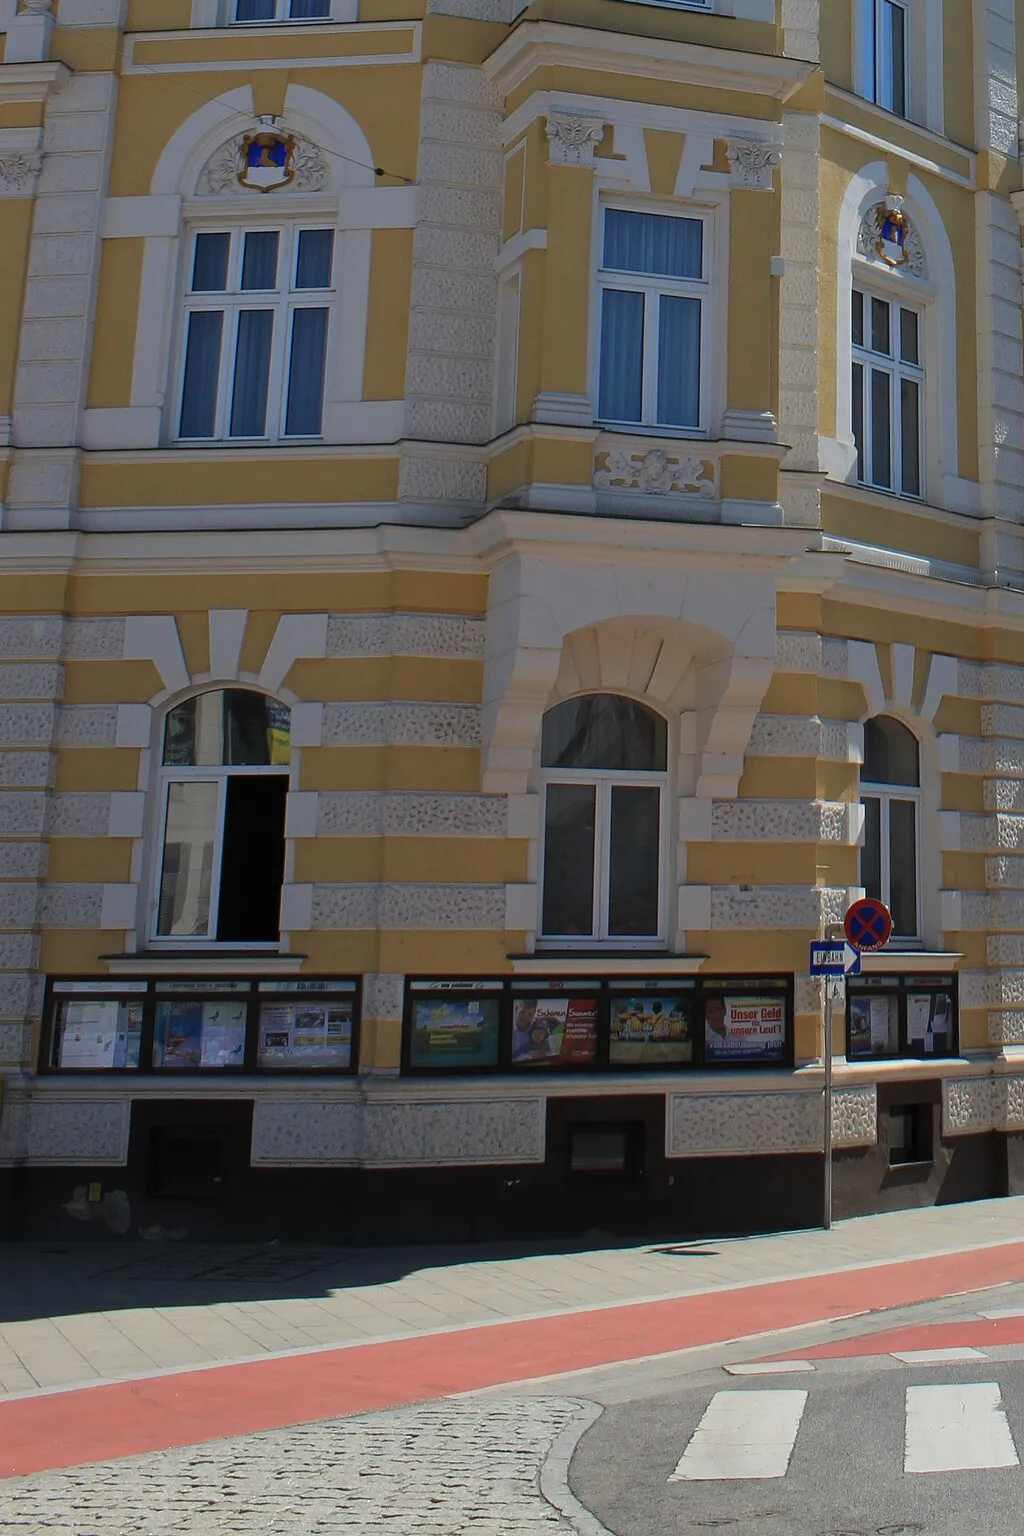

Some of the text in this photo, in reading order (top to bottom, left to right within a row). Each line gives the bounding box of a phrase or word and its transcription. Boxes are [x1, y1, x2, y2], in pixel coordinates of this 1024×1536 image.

[854, 941, 883, 952] ANFANG
[816, 950, 844, 963] EINBAHN
[731, 1008, 781, 1020] Unser Geld
[731, 1026, 758, 1035] unsere
